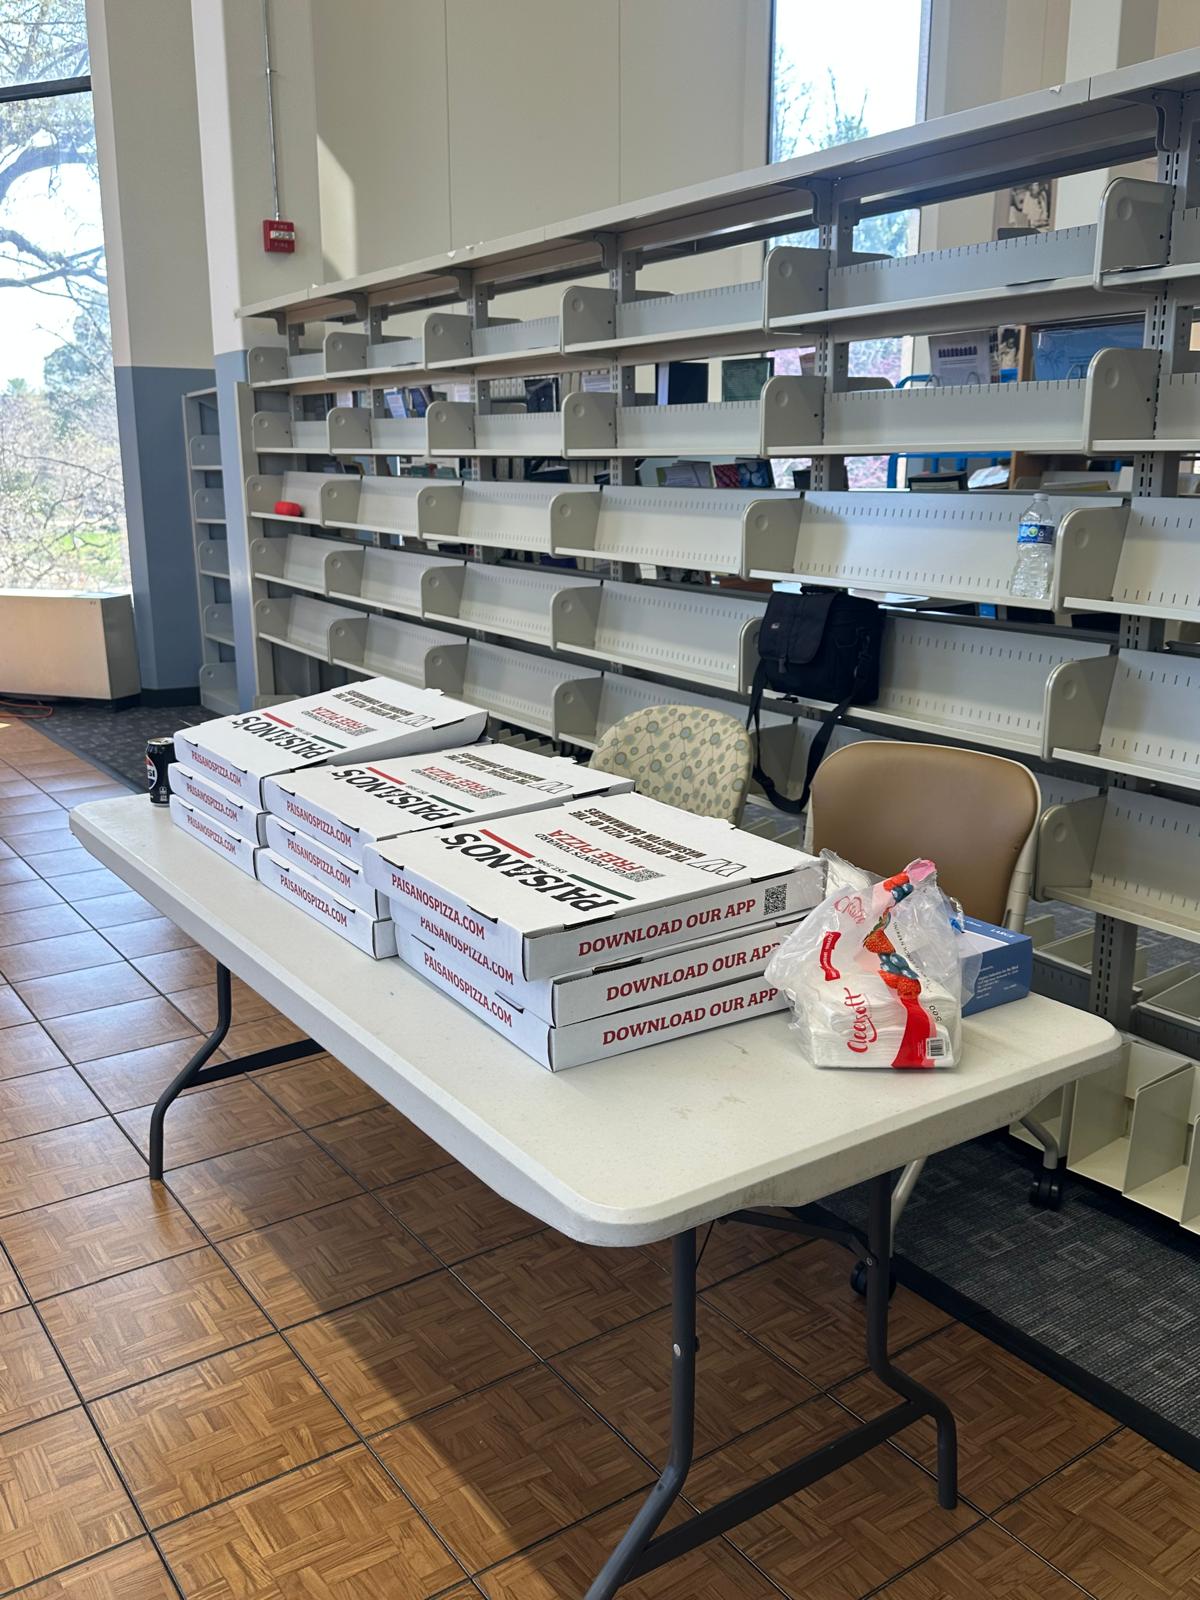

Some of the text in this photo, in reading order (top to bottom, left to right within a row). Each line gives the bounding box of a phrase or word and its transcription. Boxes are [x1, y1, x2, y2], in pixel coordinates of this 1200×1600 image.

[231, 716, 335, 760] PAISANO'S
[191, 750, 242, 787] PAISANOSPIZZA.COM
[186, 782, 238, 822] PAISANOSPIZZA.COM
[331, 768, 461, 822] PAISANO'S
[186, 814, 237, 855] PAISANOSPIZZA.COM
[286, 800, 352, 848] PAISANOSPIZZA.COM
[534, 832, 572, 854] TOWARD
[597, 824, 631, 839] PIZZA
[287, 838, 352, 888] PAISANOSPIZZA.COM
[440, 833, 619, 912] PAISANO'S
[547, 829, 645, 873] FREE PIZZA
[280, 874, 348, 927] PAISANOSPIZZA.COM
[391, 873, 486, 940] PAISANOSPIZZA.COM
[420, 916, 514, 985] PAISANOSPIZZA.COM
[578, 898, 756, 957] DOWNLOAD OUR APP
[423, 951, 513, 1028] PAISANOSPIZZA.COM
[606, 962, 709, 1001] DOWNLOAD
[711, 951, 747, 972] OUR
[602, 987, 779, 1045] DOWNLOAD OUR APP
[928, 1004, 943, 1023] 500
